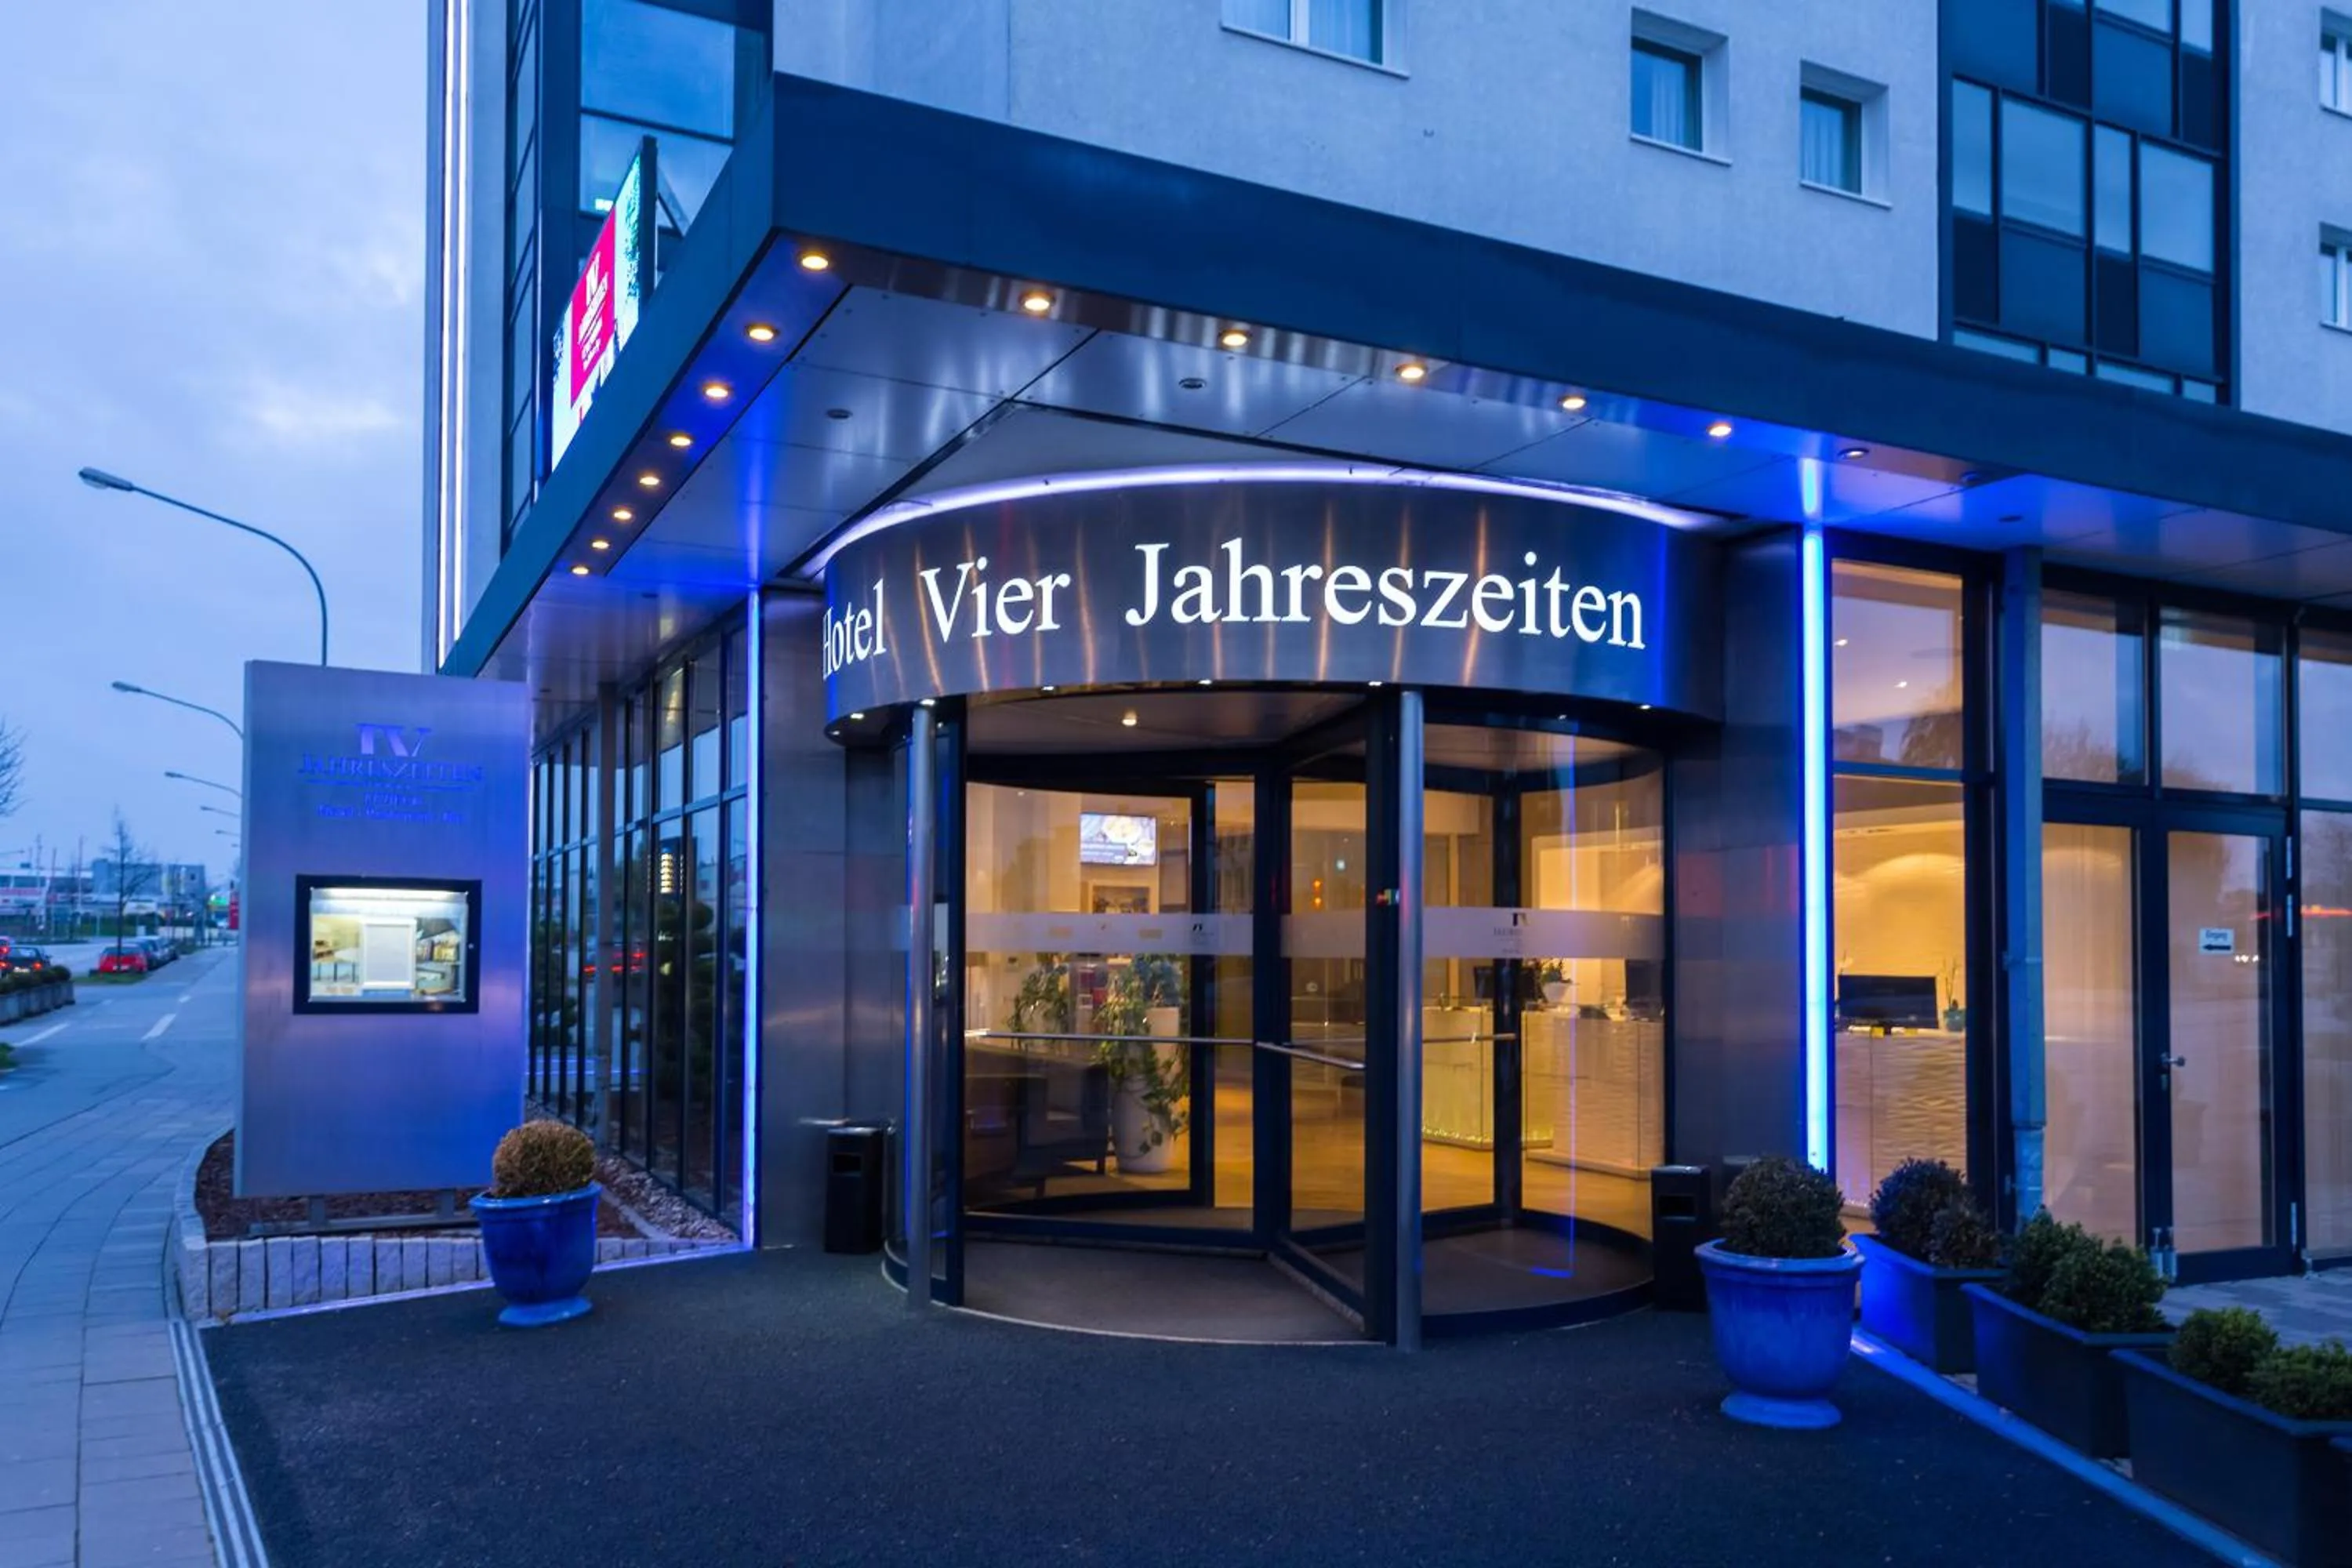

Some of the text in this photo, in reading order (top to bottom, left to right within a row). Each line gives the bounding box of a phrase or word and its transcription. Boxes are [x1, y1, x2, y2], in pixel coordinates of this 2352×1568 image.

[822, 537, 1646, 681] Hotel Vier Jahreszeiten
